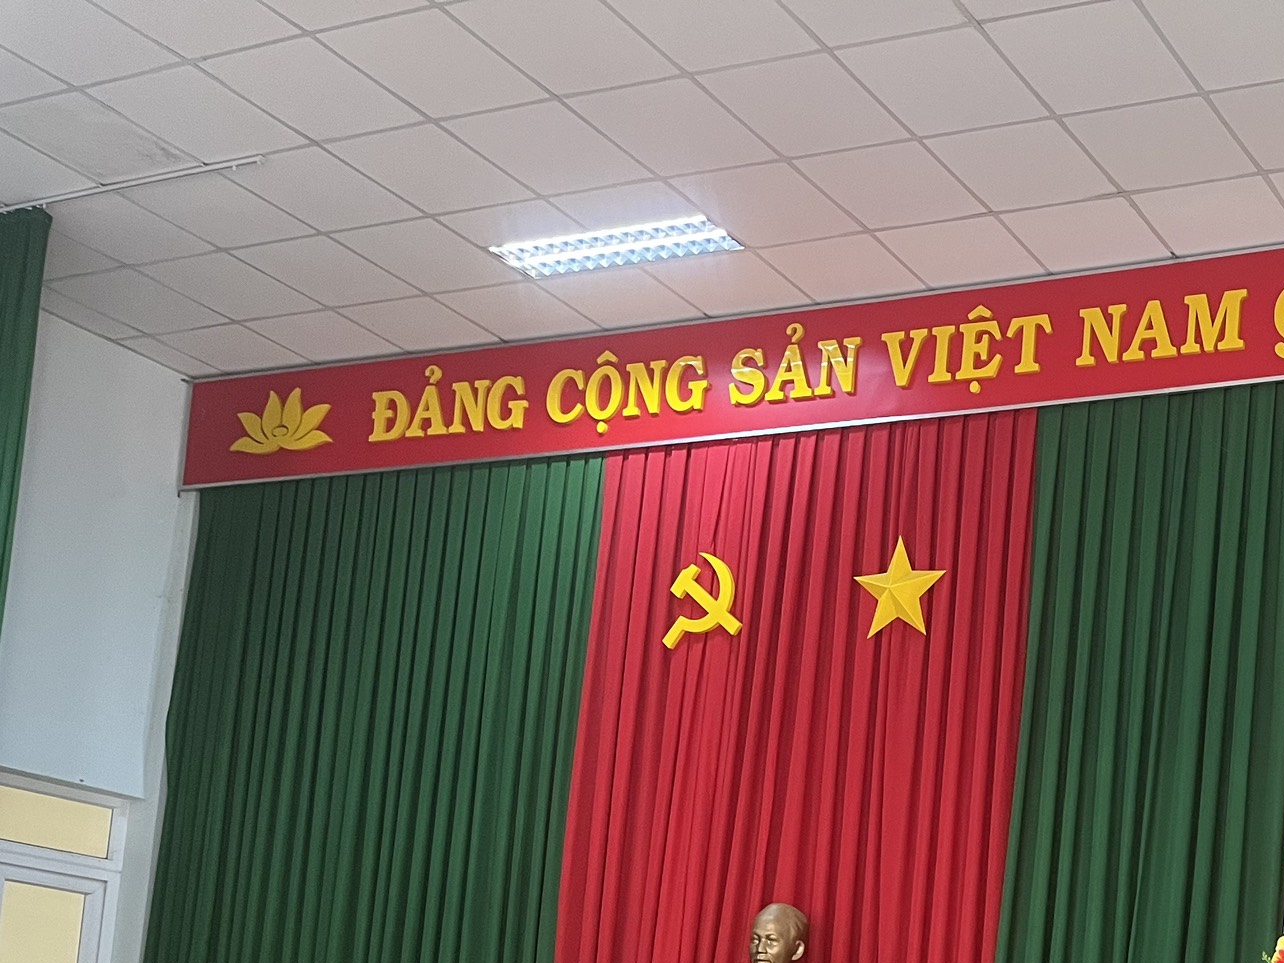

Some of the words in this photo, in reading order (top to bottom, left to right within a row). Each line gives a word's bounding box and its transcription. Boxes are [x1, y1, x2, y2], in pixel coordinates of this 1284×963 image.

[368, 365, 529, 442] ĐẢNG
[546, 350, 712, 434] CỘNG
[728, 322, 862, 405] SẢN
[882, 304, 1054, 394] VIỆT
[1075, 288, 1249, 367] NAM
